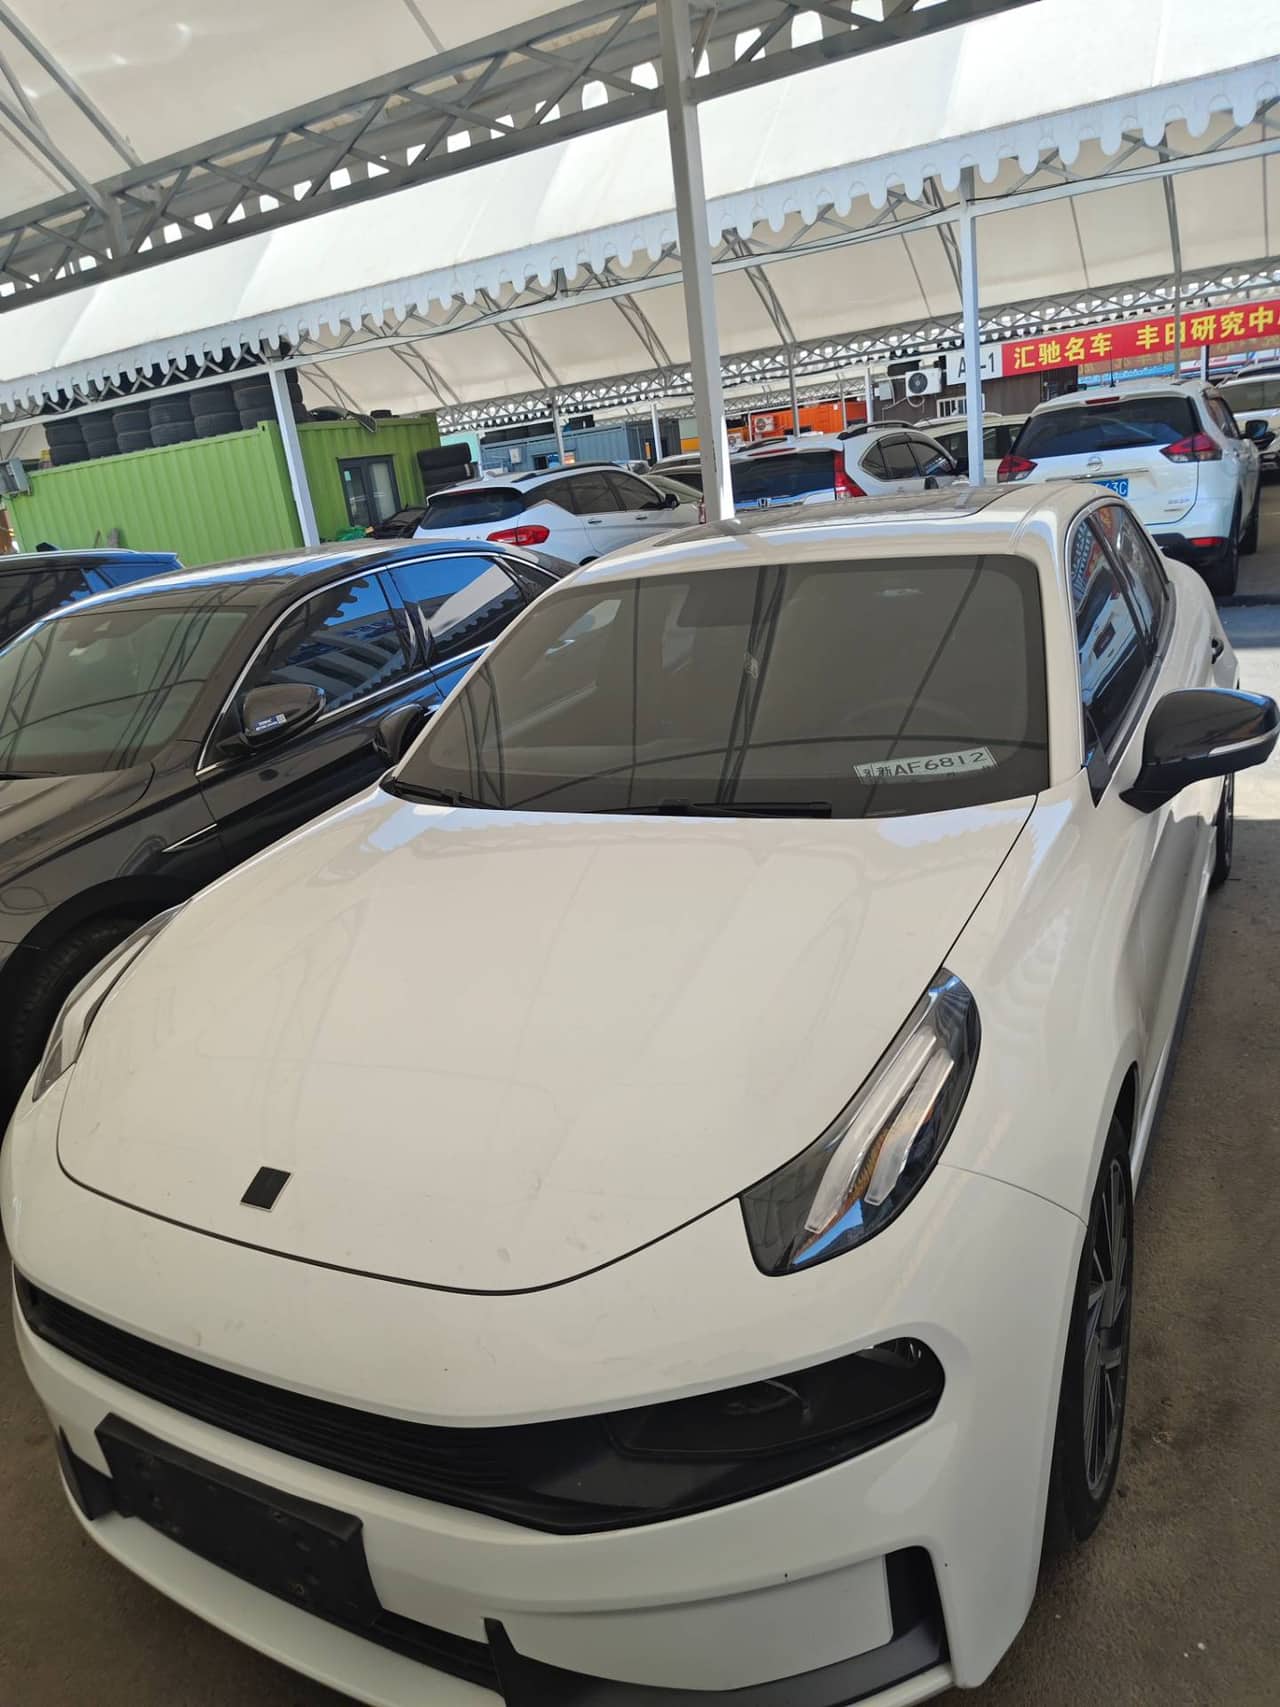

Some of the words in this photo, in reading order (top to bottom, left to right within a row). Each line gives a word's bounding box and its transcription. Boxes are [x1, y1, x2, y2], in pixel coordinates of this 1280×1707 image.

[1013, 333, 1113, 369] 汇驰名车
[1136, 305, 1280, 349] 丰田研究中
